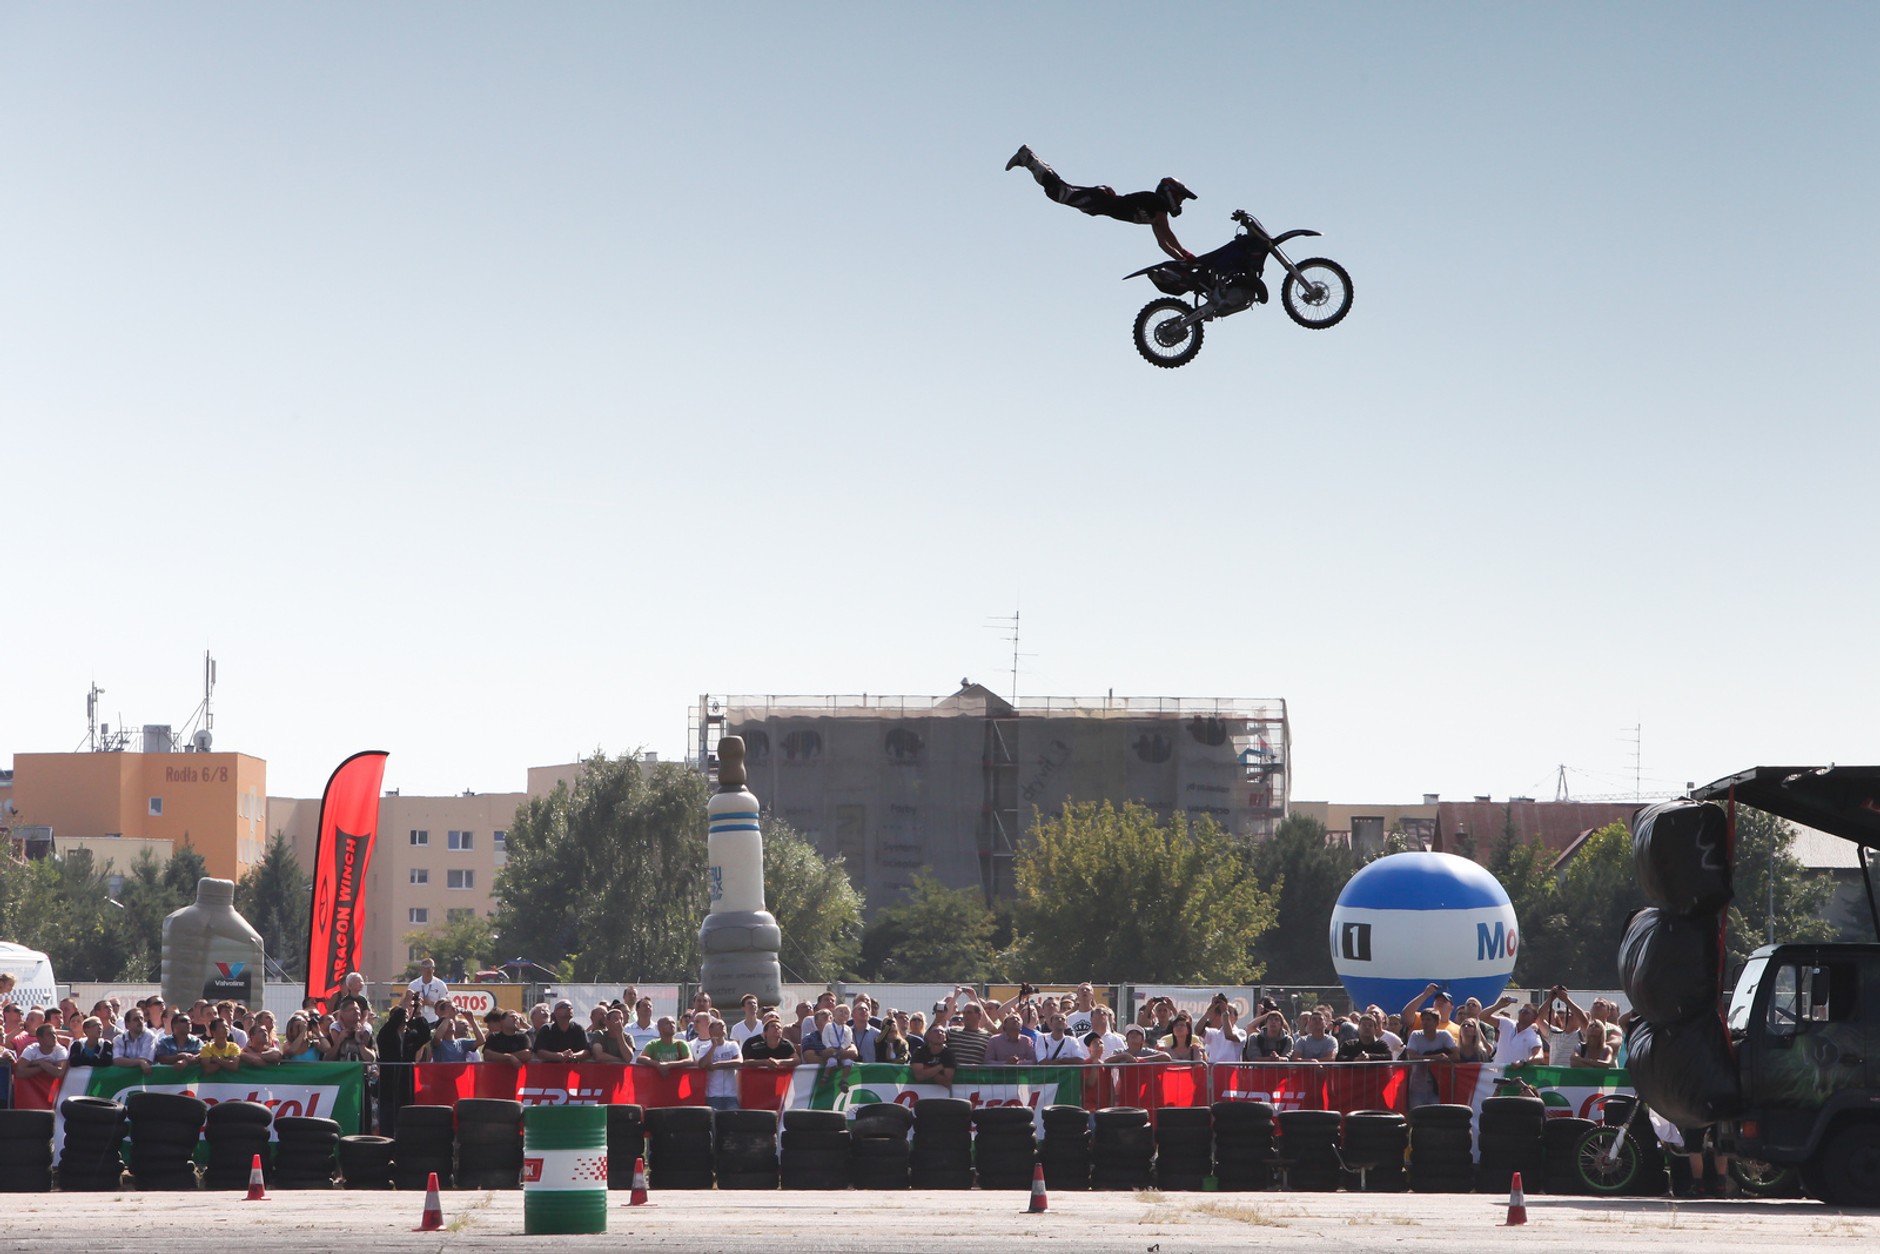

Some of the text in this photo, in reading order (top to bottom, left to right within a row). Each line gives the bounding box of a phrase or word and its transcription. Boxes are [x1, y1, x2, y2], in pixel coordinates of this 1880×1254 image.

[165, 766, 228, 783] Rodła 6/8
[338, 838, 357, 902] WINCH
[452, 995, 488, 1011] OTOS
